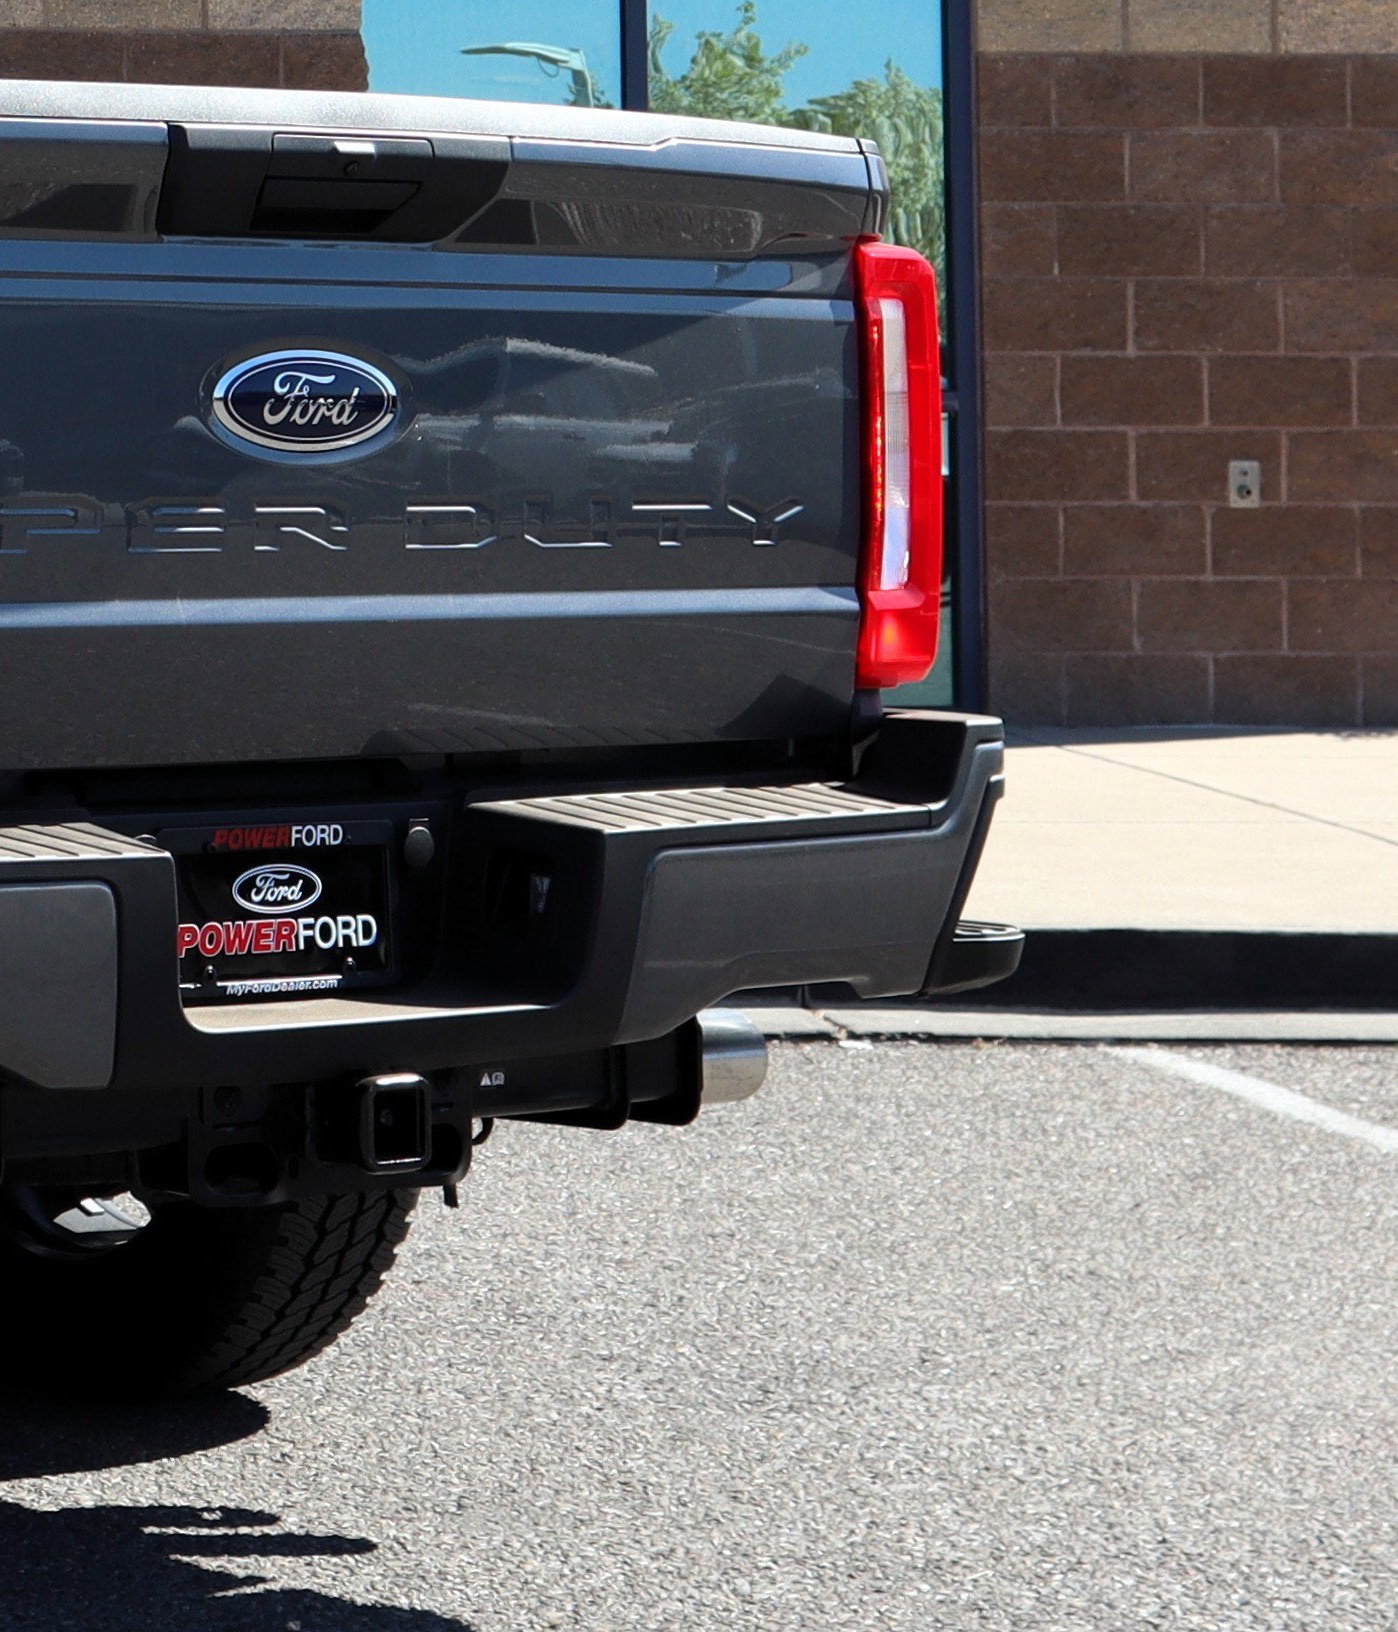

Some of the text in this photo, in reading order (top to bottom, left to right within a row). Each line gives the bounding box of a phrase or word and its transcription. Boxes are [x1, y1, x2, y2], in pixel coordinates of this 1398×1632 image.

[262, 371, 360, 426] Ford
[404, 497, 804, 549] DUTY
[250, 872, 303, 902] Ford
